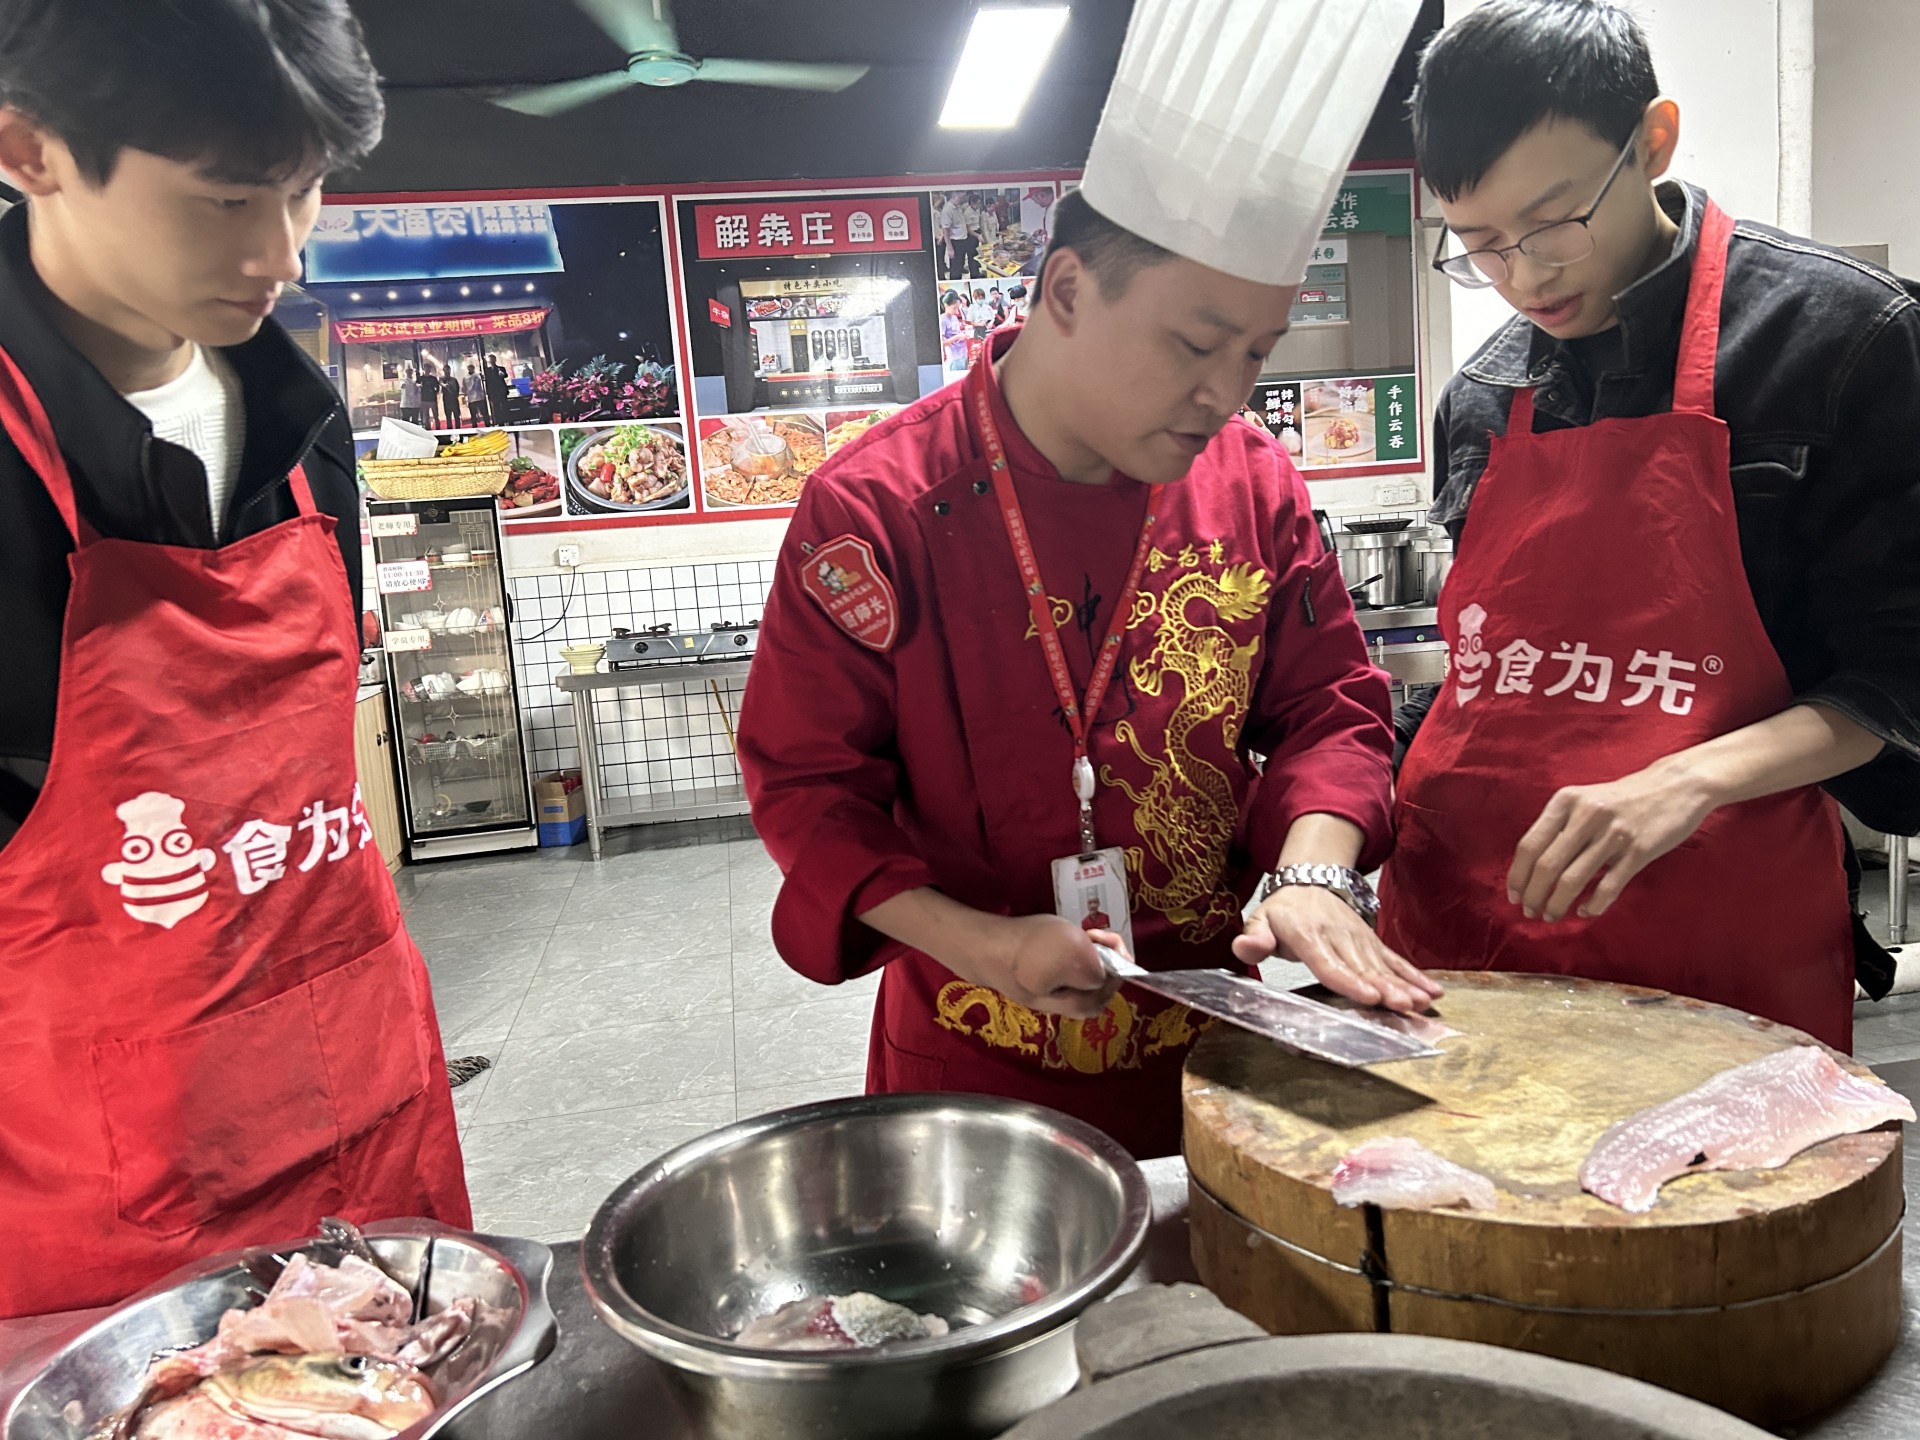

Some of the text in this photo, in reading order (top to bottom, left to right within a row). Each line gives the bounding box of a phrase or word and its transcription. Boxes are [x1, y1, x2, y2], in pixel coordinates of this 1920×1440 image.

[715, 212, 834, 248] 解犇庄
[1322, 211, 1360, 229] 云吞
[1387, 385, 1405, 448] 手作云吞
[1494, 638, 1697, 716] 食为先
